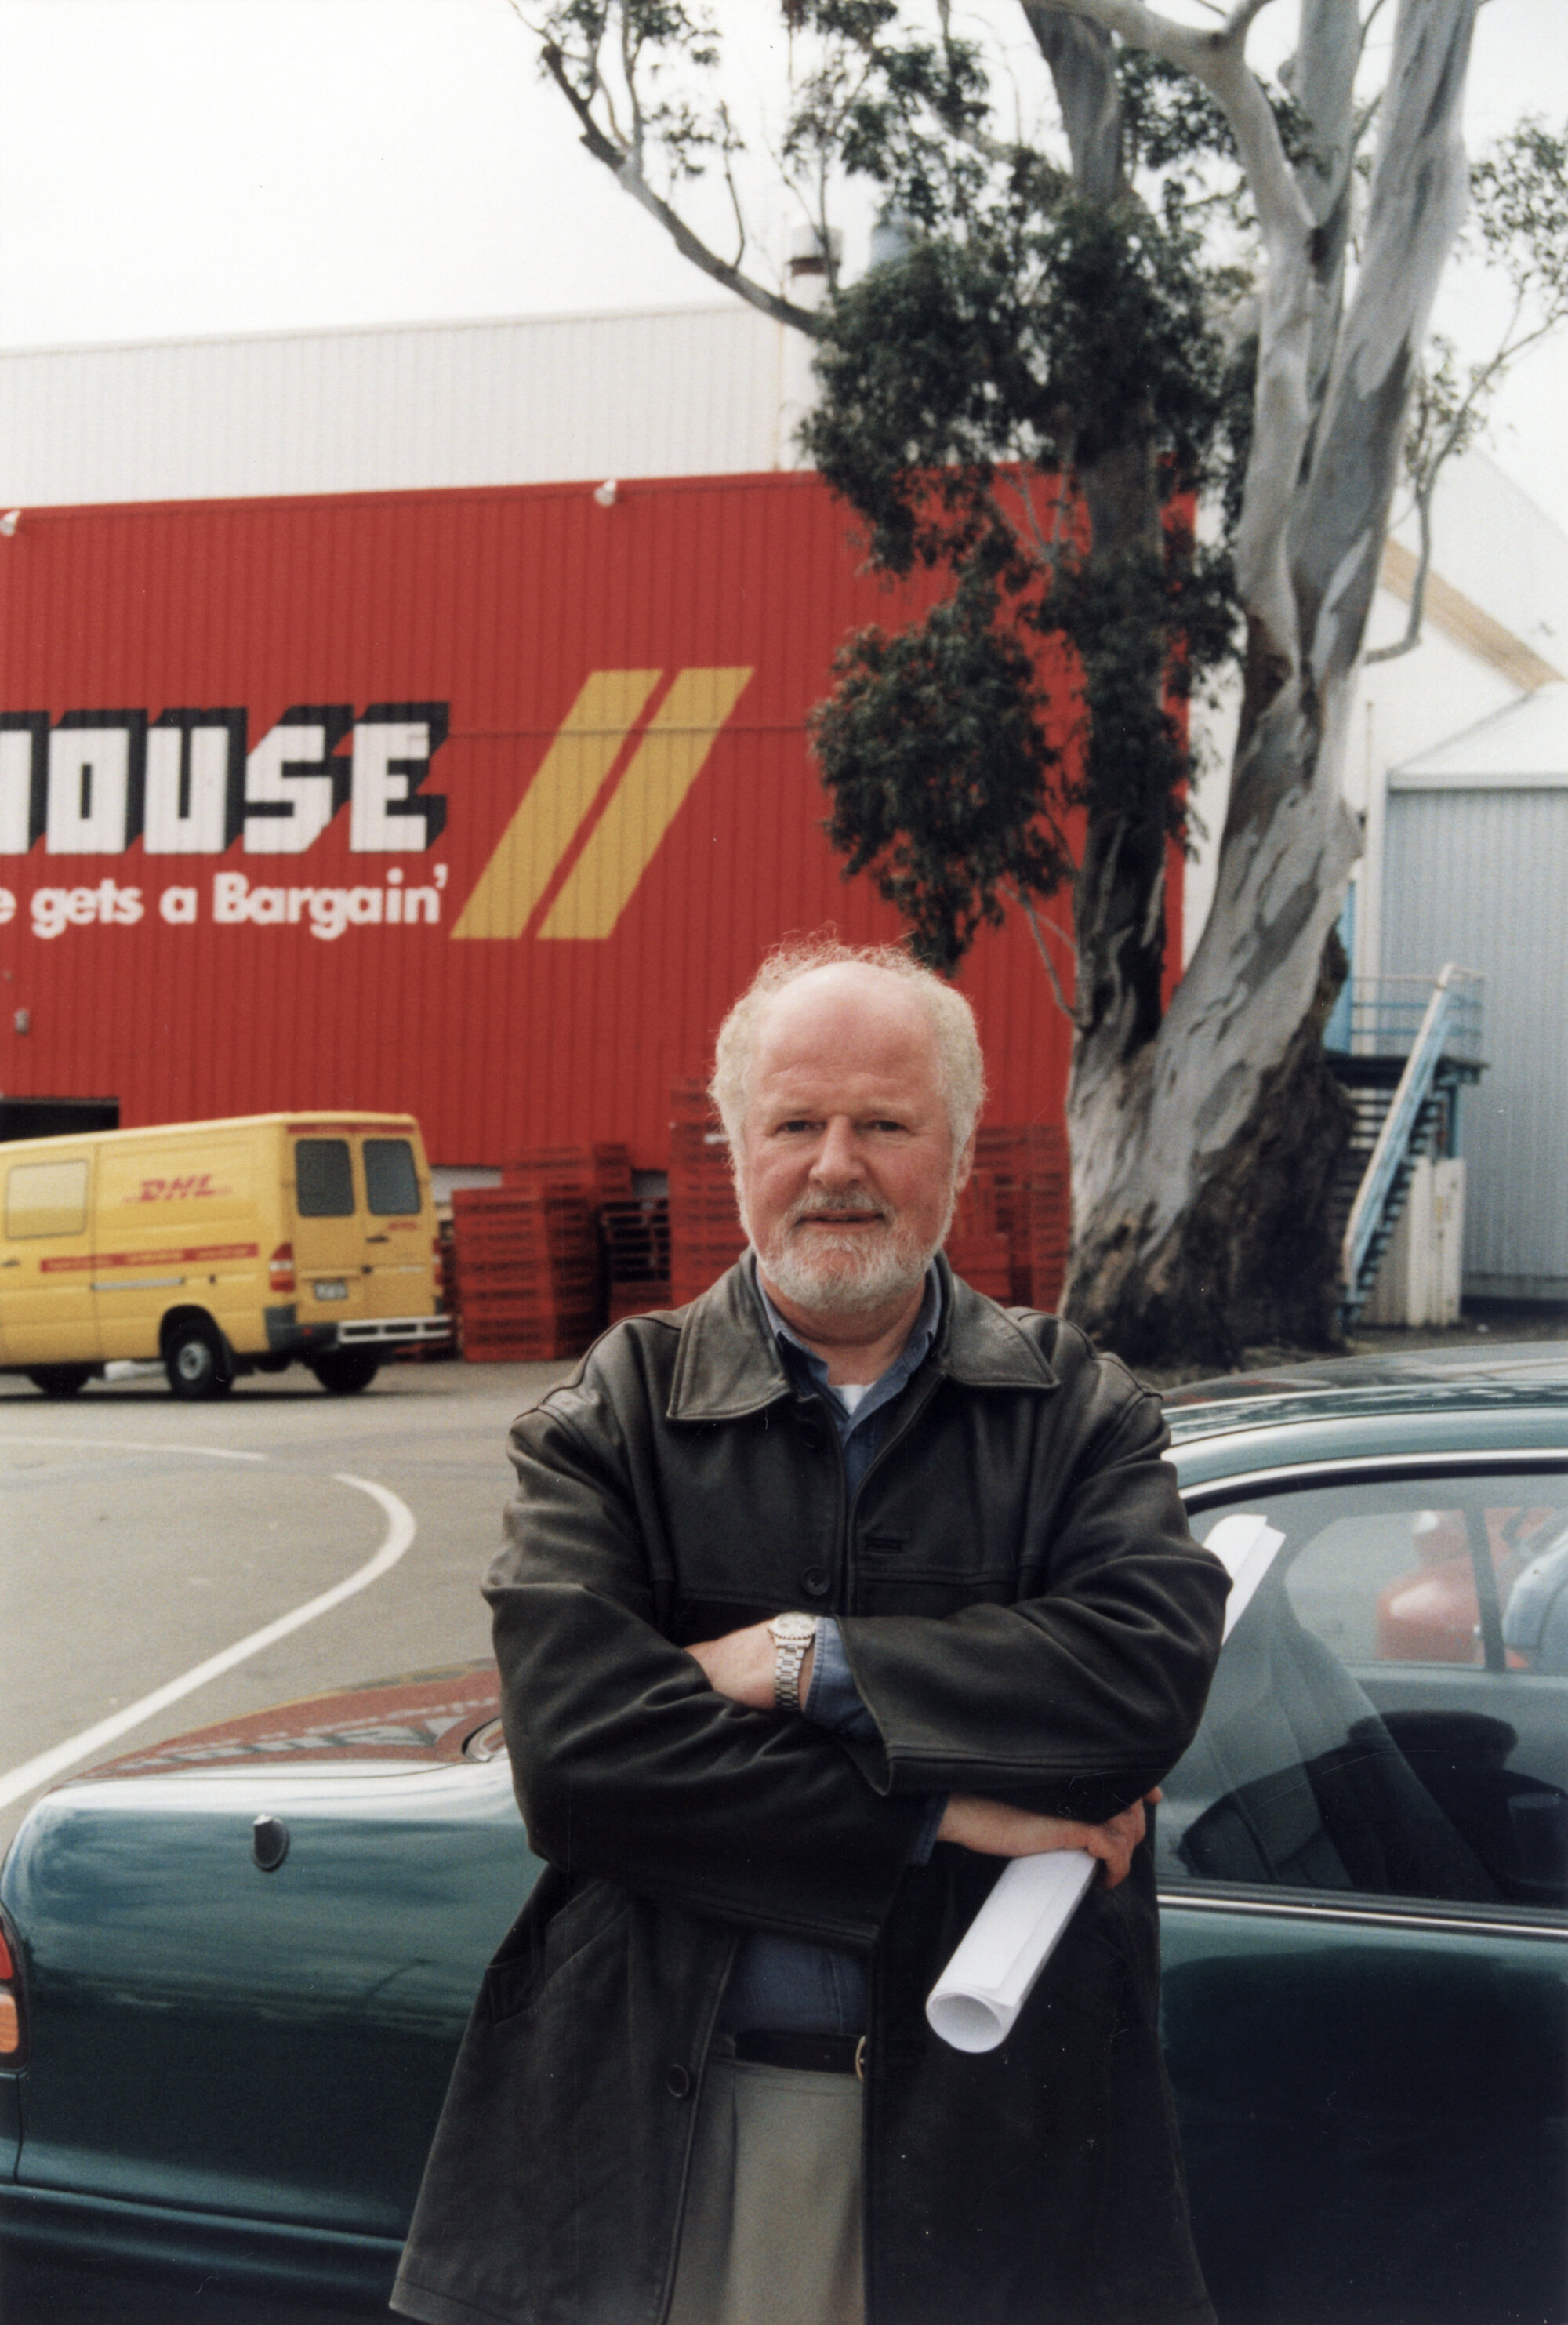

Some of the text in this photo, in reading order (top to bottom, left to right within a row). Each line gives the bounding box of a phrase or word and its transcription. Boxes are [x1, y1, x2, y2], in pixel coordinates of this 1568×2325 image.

[30, 878, 144, 939] gets
[159, 886, 198, 924] a
[140, 1175, 213, 1201] DHL
